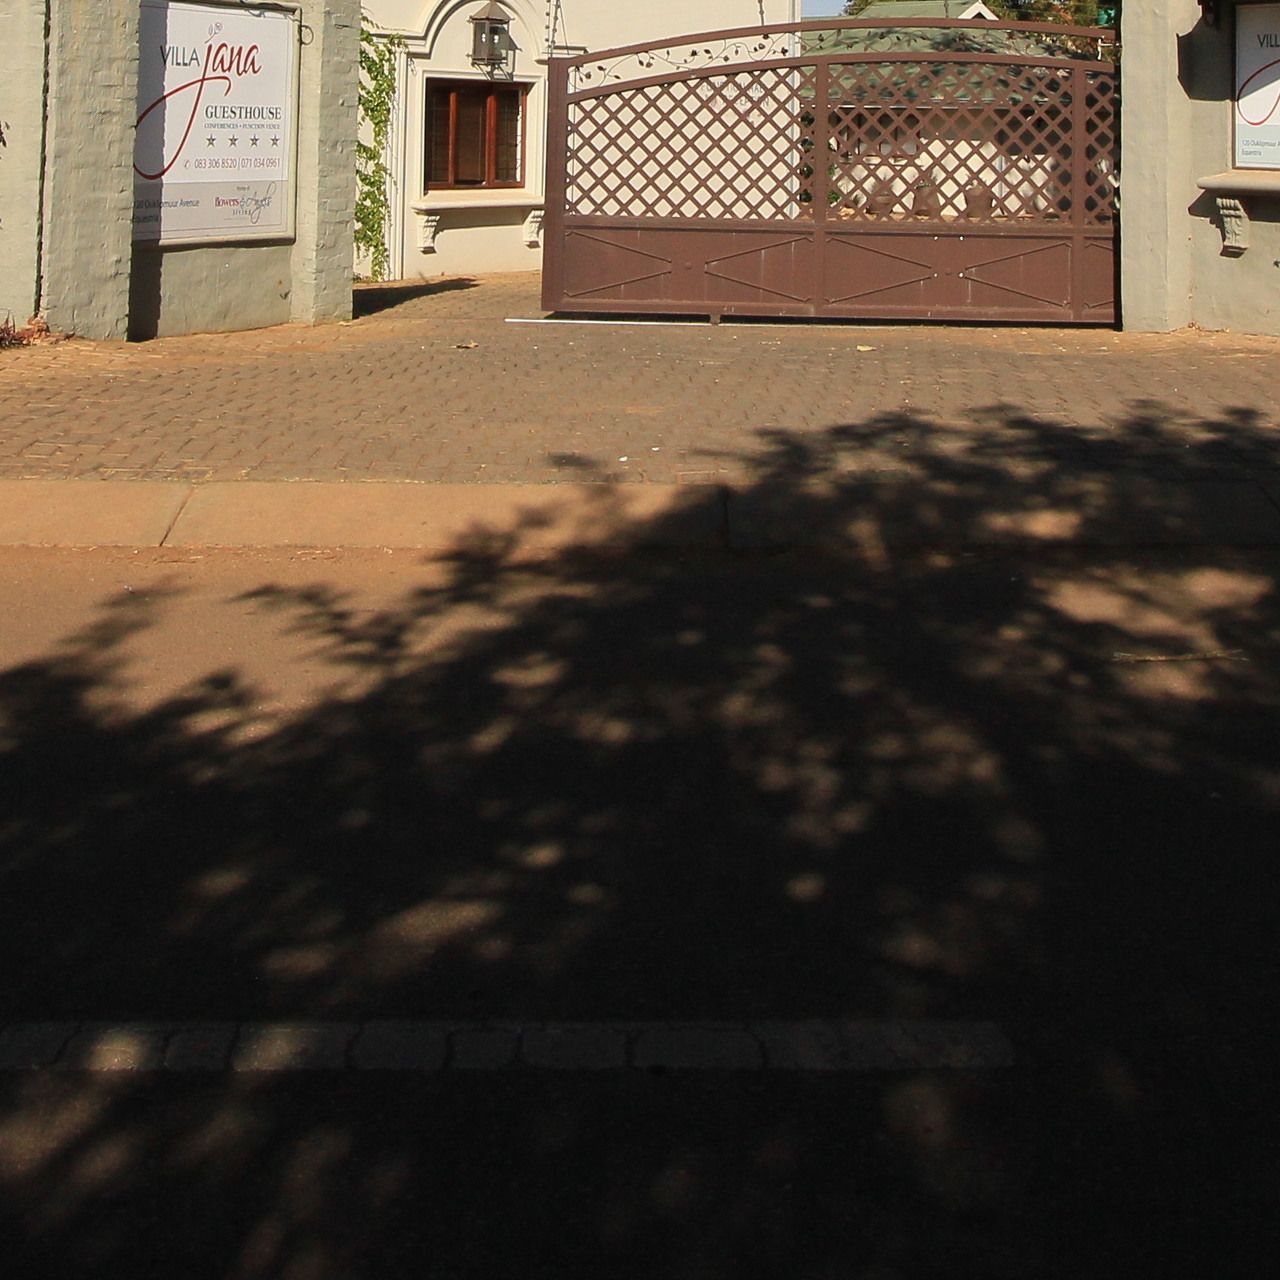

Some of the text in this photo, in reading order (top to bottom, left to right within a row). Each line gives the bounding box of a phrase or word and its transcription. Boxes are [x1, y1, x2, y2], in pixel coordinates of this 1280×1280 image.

[160, 45, 200, 67] VILLA
[205, 104, 282, 120] GUESTHOUSE
[195, 159, 206, 168] 083
[208, 159, 220, 168] 306
[253, 158, 264, 168] 034
